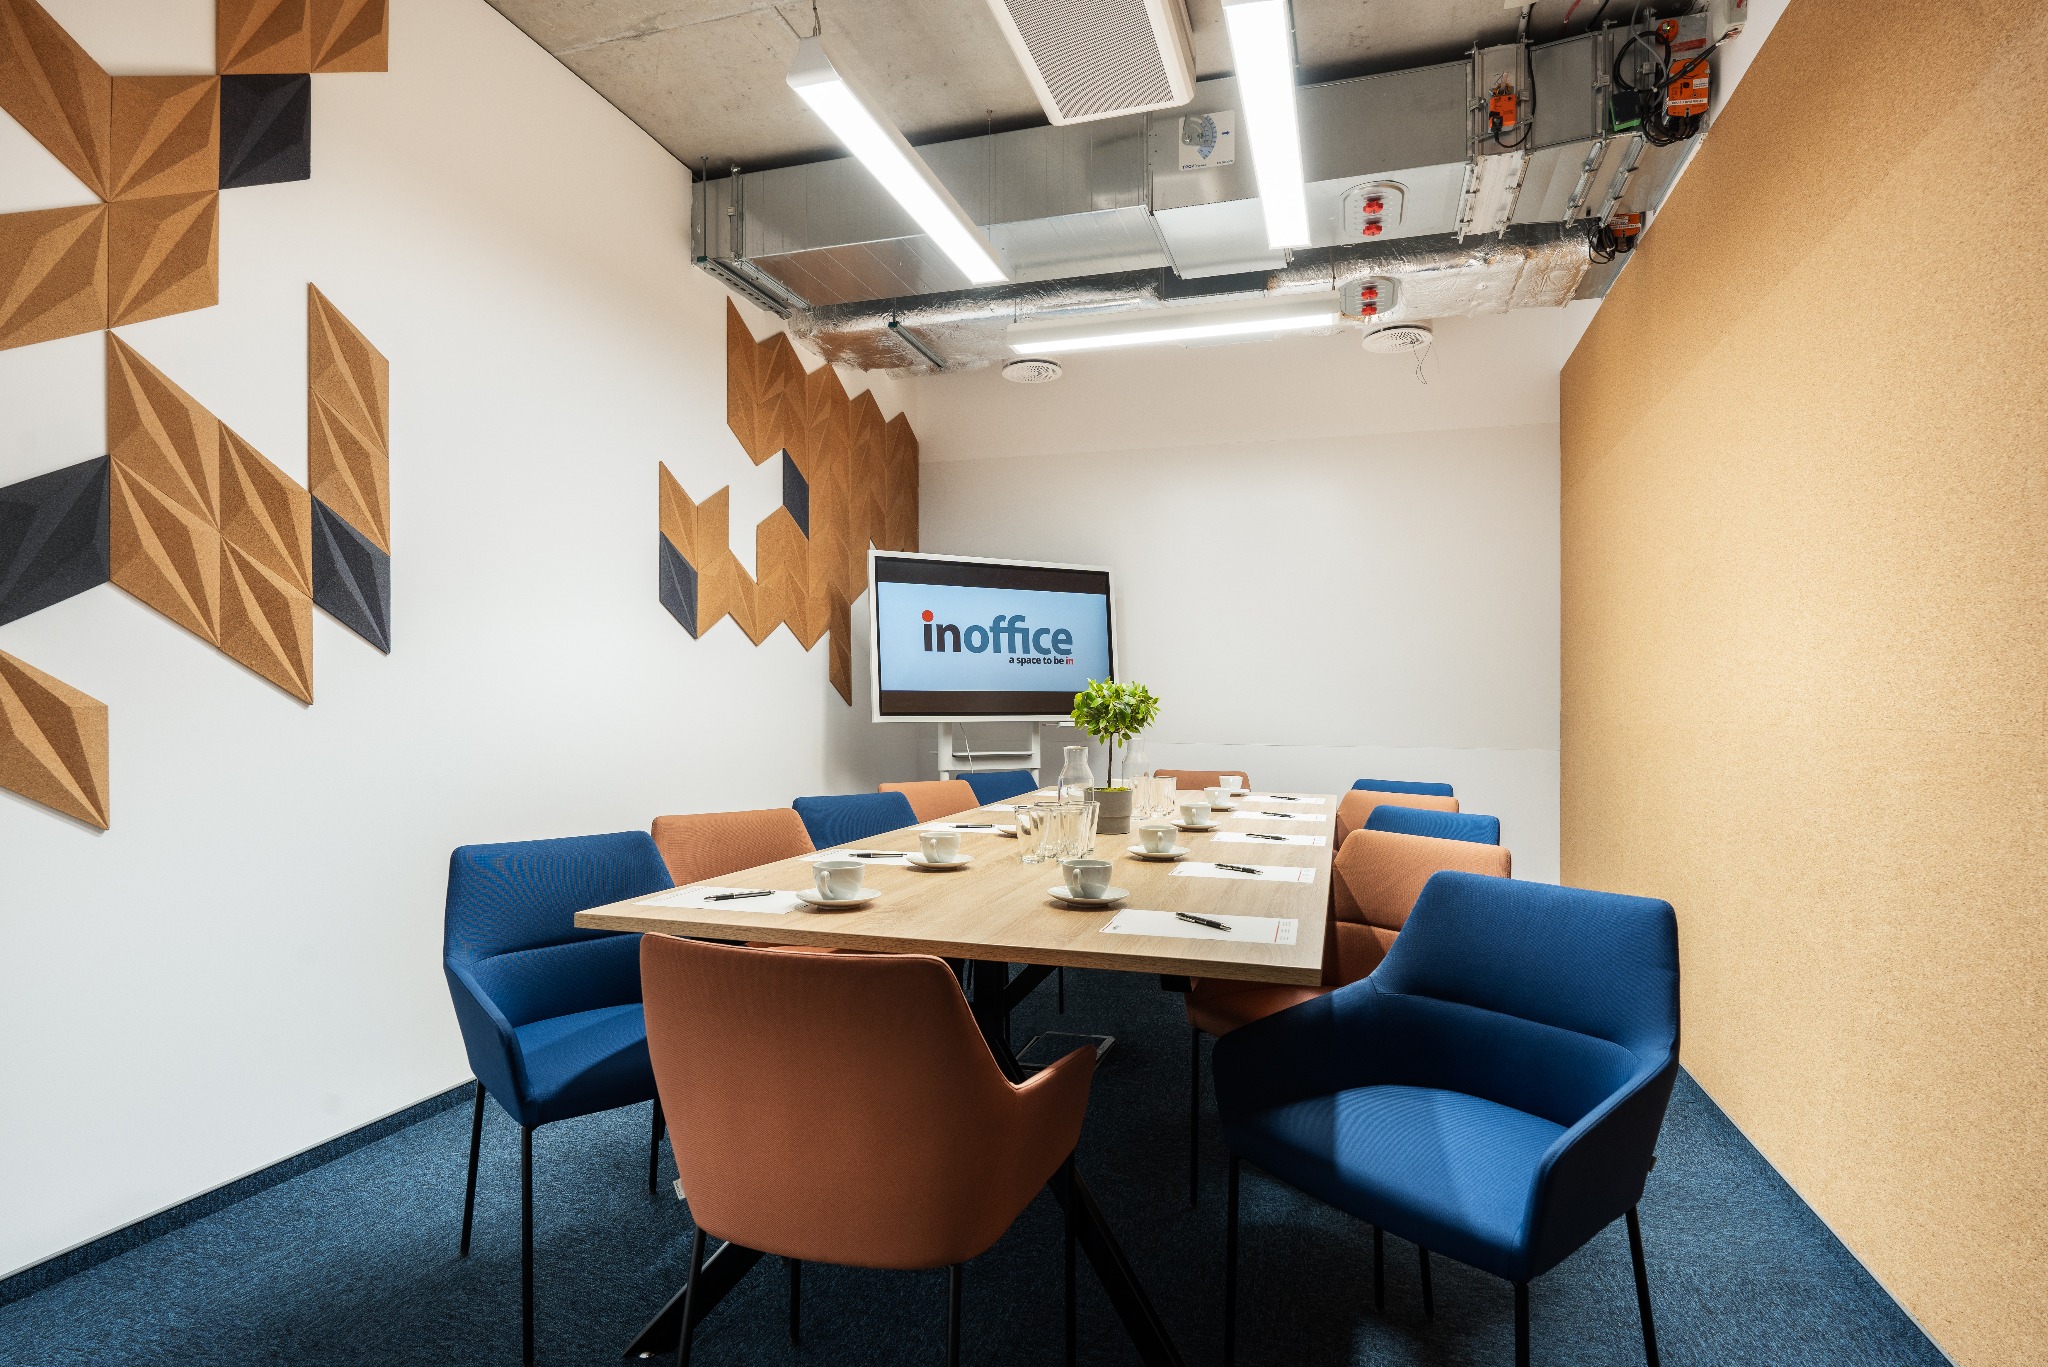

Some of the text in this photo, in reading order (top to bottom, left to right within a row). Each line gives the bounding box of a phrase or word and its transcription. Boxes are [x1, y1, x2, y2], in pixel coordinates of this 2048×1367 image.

[921, 609, 1073, 656] inoffice
[1016, 656, 1042, 666] space
[1043, 656, 1052, 665] to
[1053, 656, 1064, 665] be
[1065, 656, 1074, 665] in
